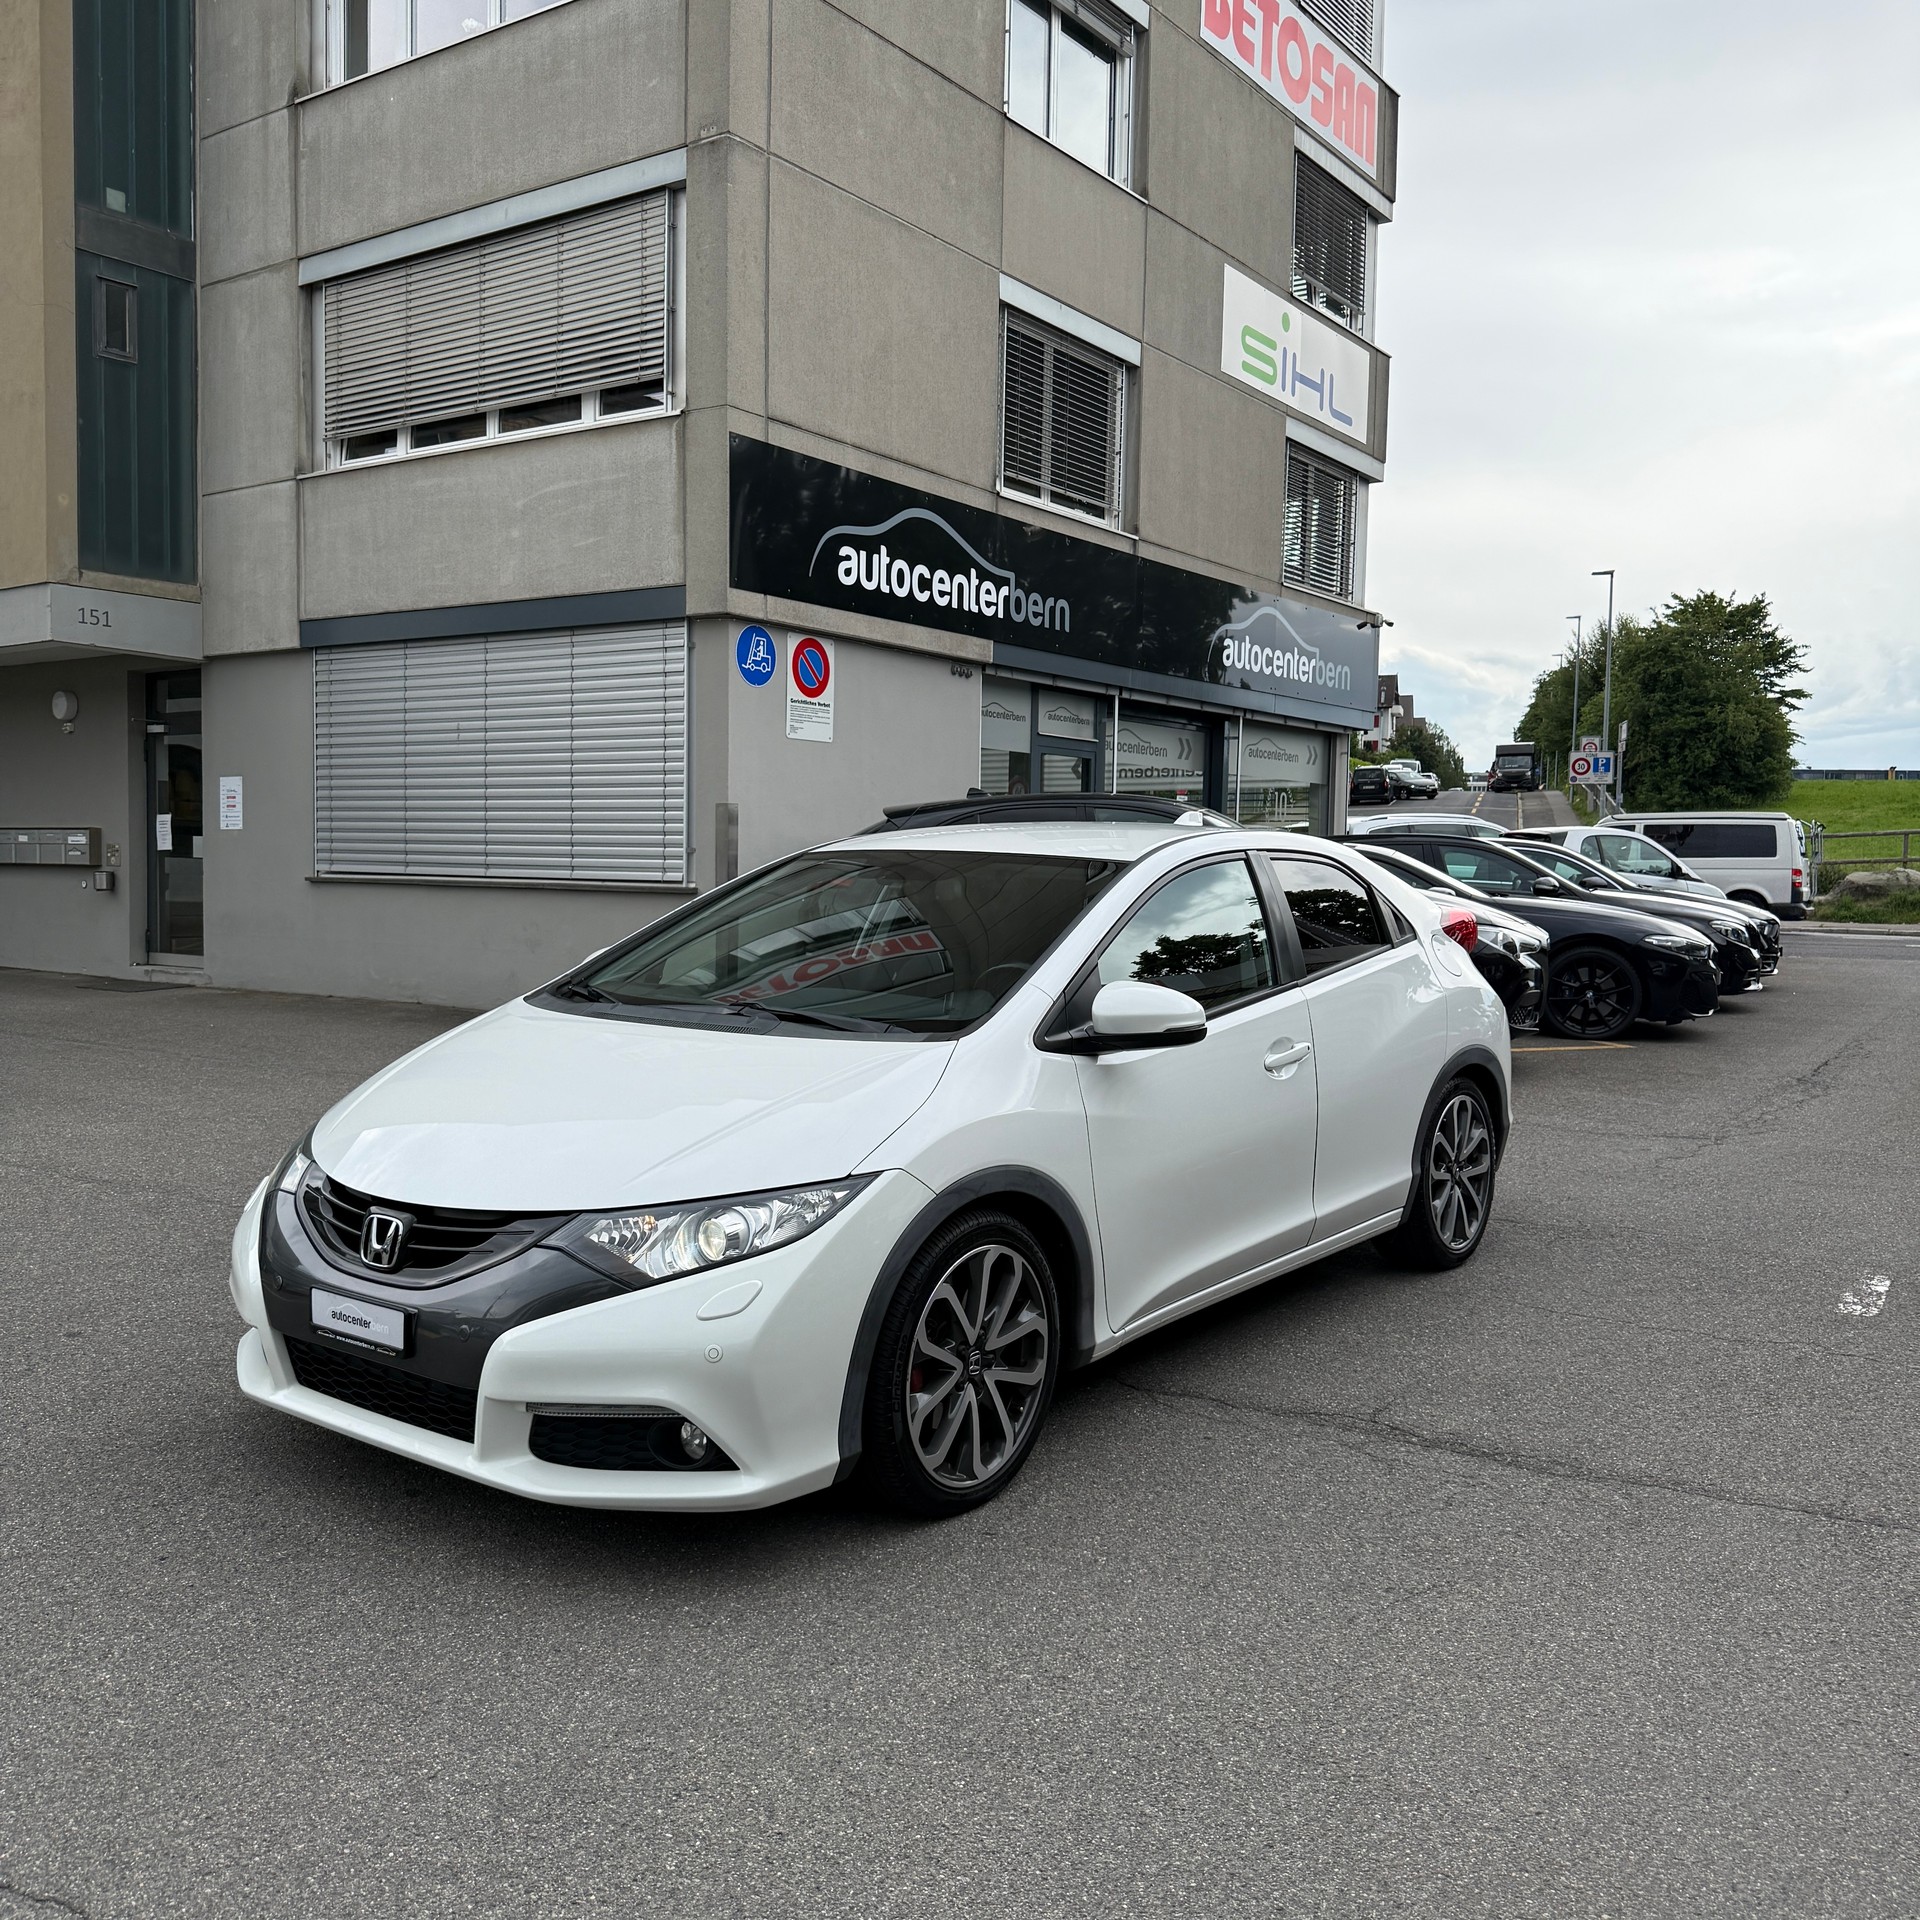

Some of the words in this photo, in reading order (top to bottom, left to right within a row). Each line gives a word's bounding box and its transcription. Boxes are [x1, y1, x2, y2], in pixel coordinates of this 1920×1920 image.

[837, 545, 1070, 633] autocenterbern
[77, 607, 112, 628] 151
[1222, 635, 1350, 691] autocenterbern
[982, 708, 1027, 722] utocenterbern
[1248, 747, 1299, 763] autocenterbern
